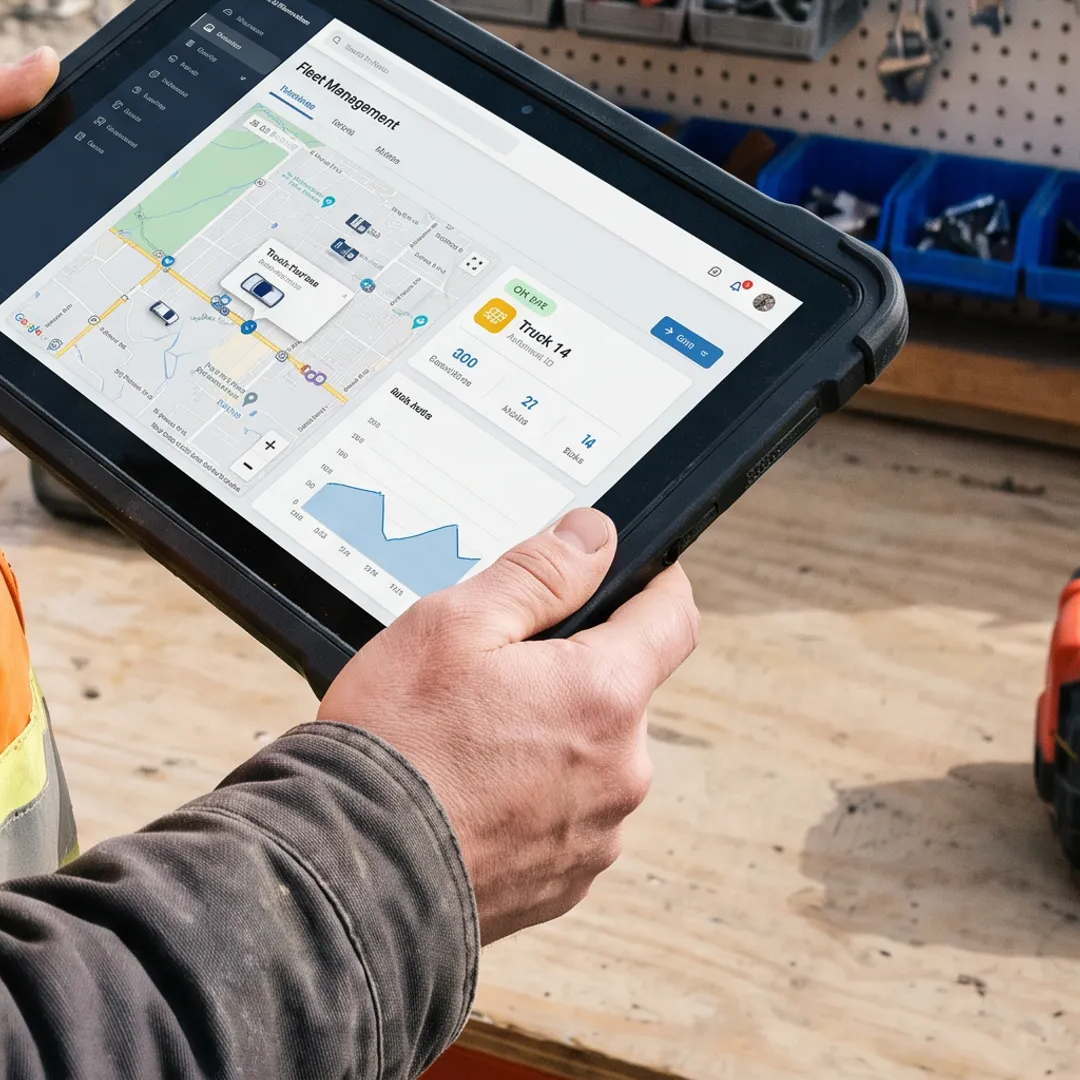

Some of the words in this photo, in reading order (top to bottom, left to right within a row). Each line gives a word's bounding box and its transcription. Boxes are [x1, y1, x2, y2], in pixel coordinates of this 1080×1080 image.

[296, 61, 327, 85] Fleet
[323, 78, 401, 131] Management
[519, 319, 554, 348] Truck
[553, 342, 572, 359] 14
[520, 395, 539, 411] 27
[581, 433, 596, 449] 14
